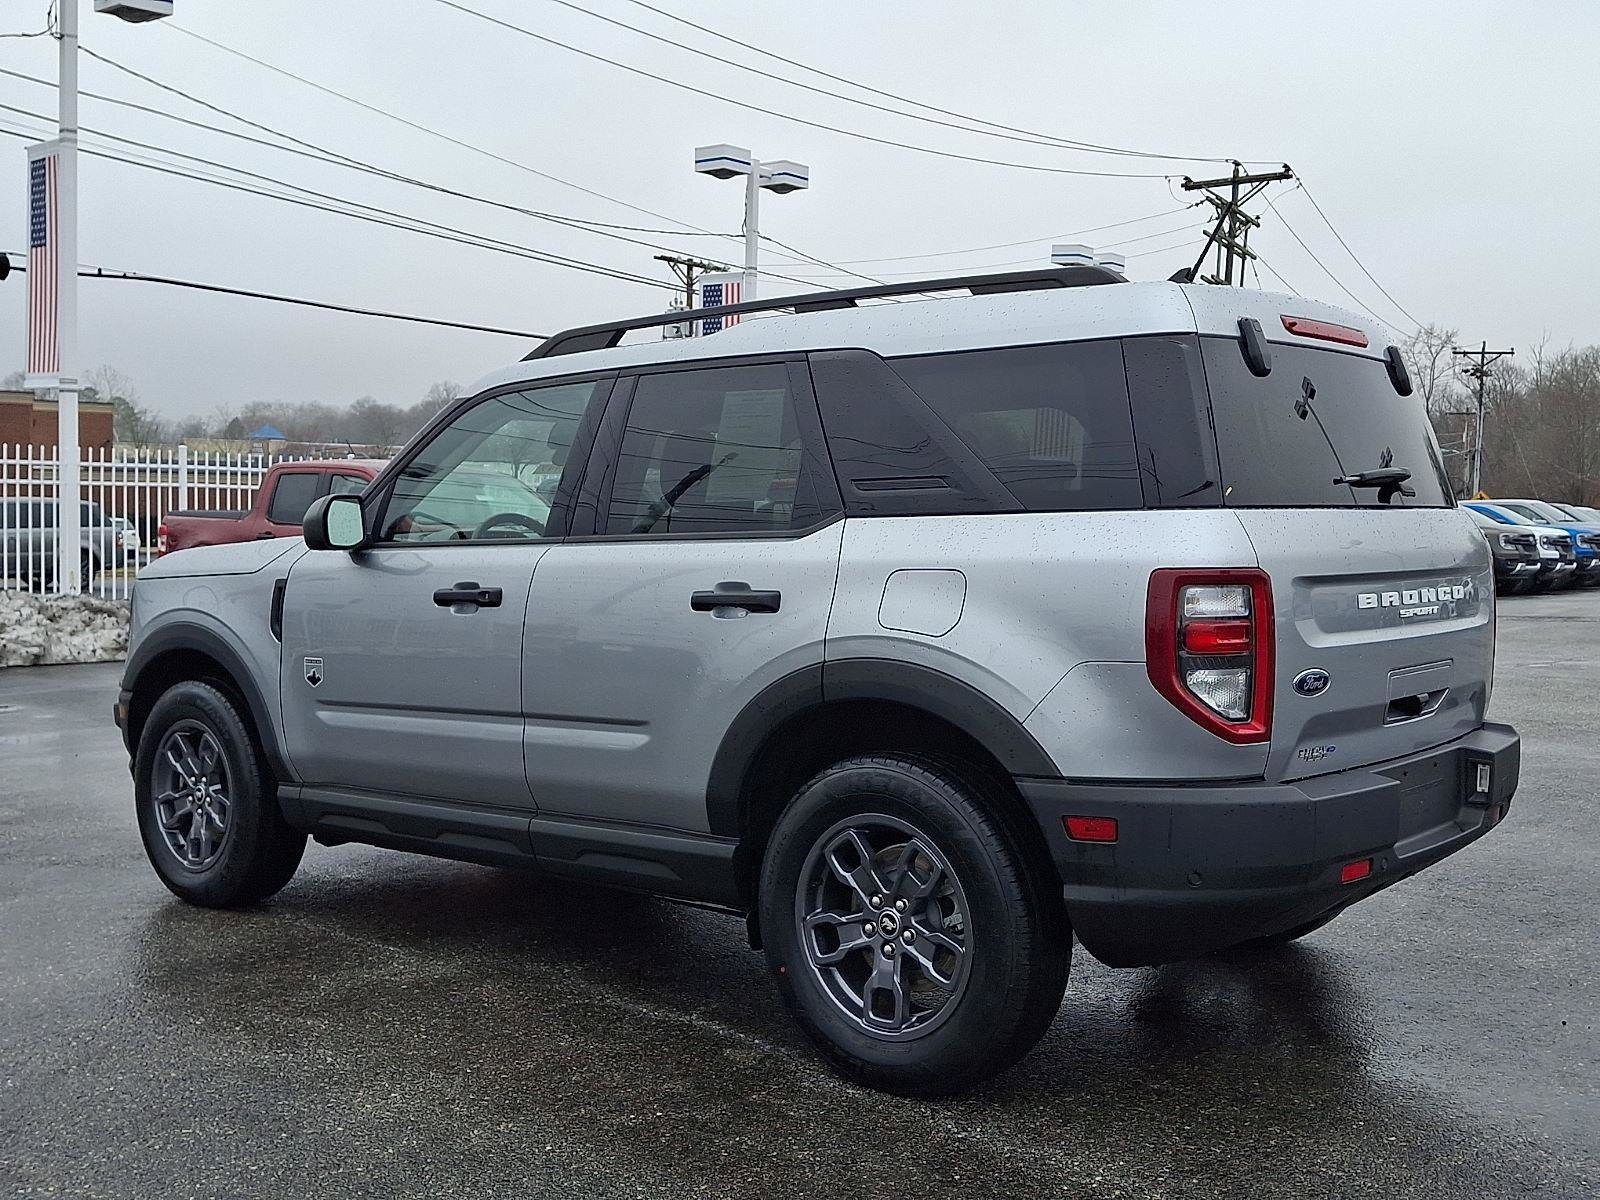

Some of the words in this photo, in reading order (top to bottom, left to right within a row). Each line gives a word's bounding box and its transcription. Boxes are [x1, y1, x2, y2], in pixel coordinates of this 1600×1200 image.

[1358, 585, 1464, 609] BRONCO
[1399, 605, 1440, 618] SPORT
[1303, 674, 1325, 691] Ford
